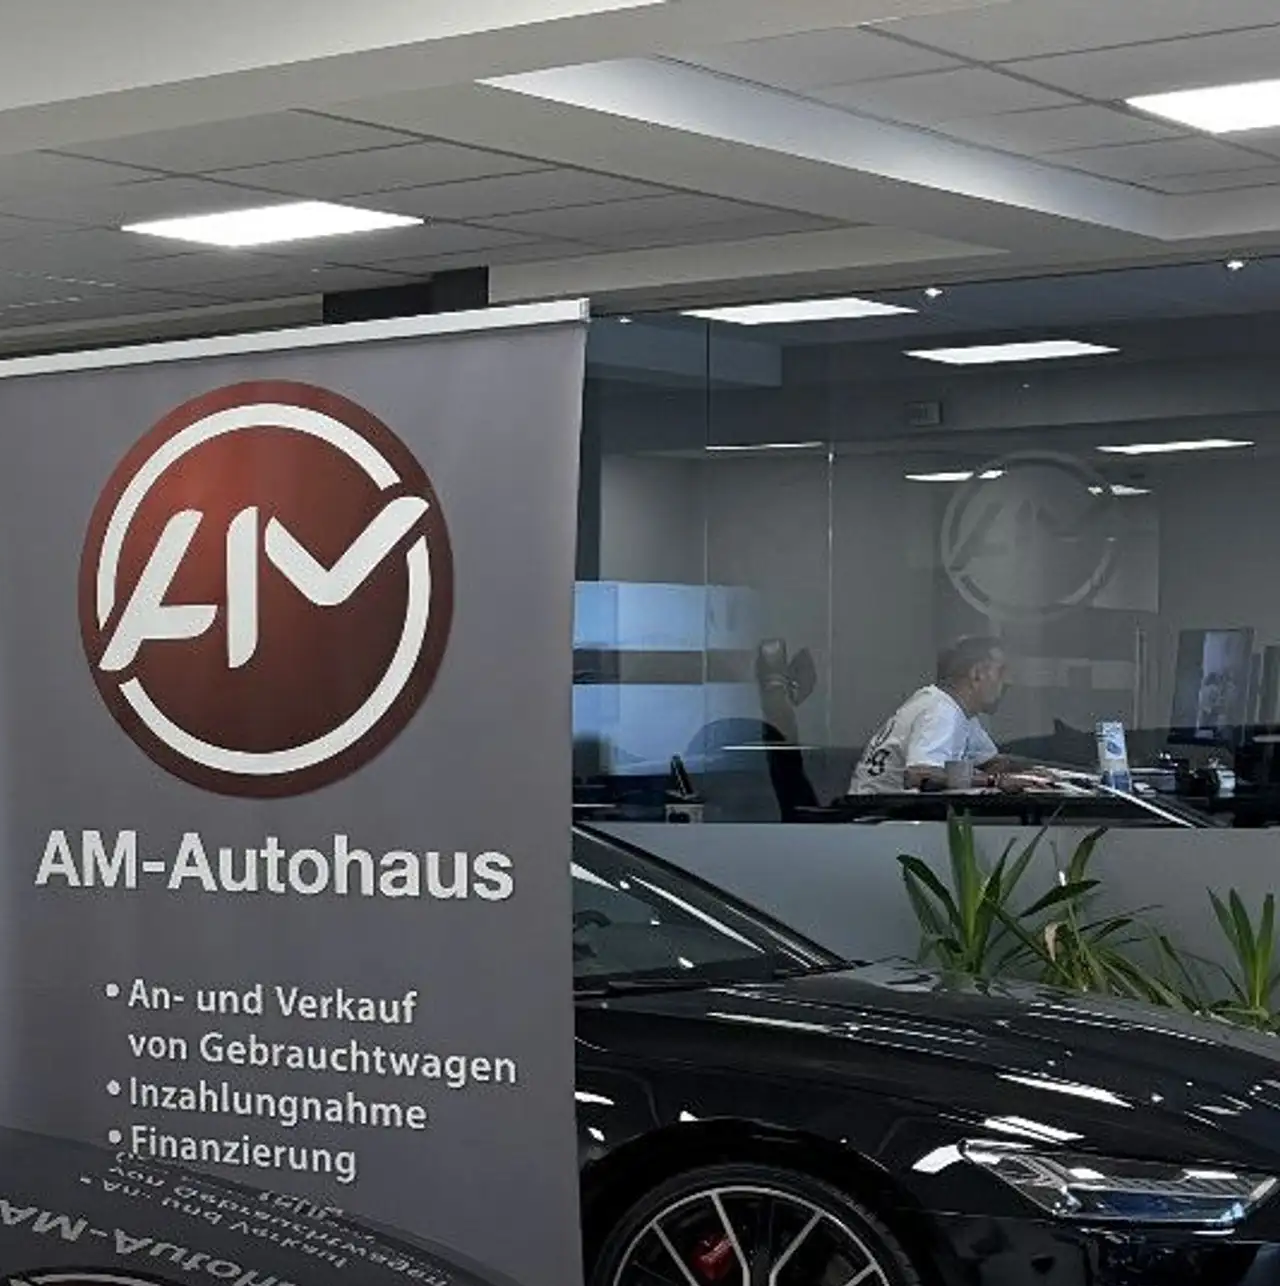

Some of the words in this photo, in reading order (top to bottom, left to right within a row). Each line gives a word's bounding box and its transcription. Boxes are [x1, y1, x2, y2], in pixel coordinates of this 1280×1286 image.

[34, 828, 515, 901] AM-Autohaus
[127, 978, 185, 1010] An-
[197, 984, 264, 1016] und
[275, 985, 418, 1025] Verkauf
[127, 1032, 188, 1061] von
[199, 1031, 518, 1089] Gebrauchtwagen
[128, 1077, 428, 1130] Inzahlungnahme
[130, 1125, 357, 1183] Finanzierung
